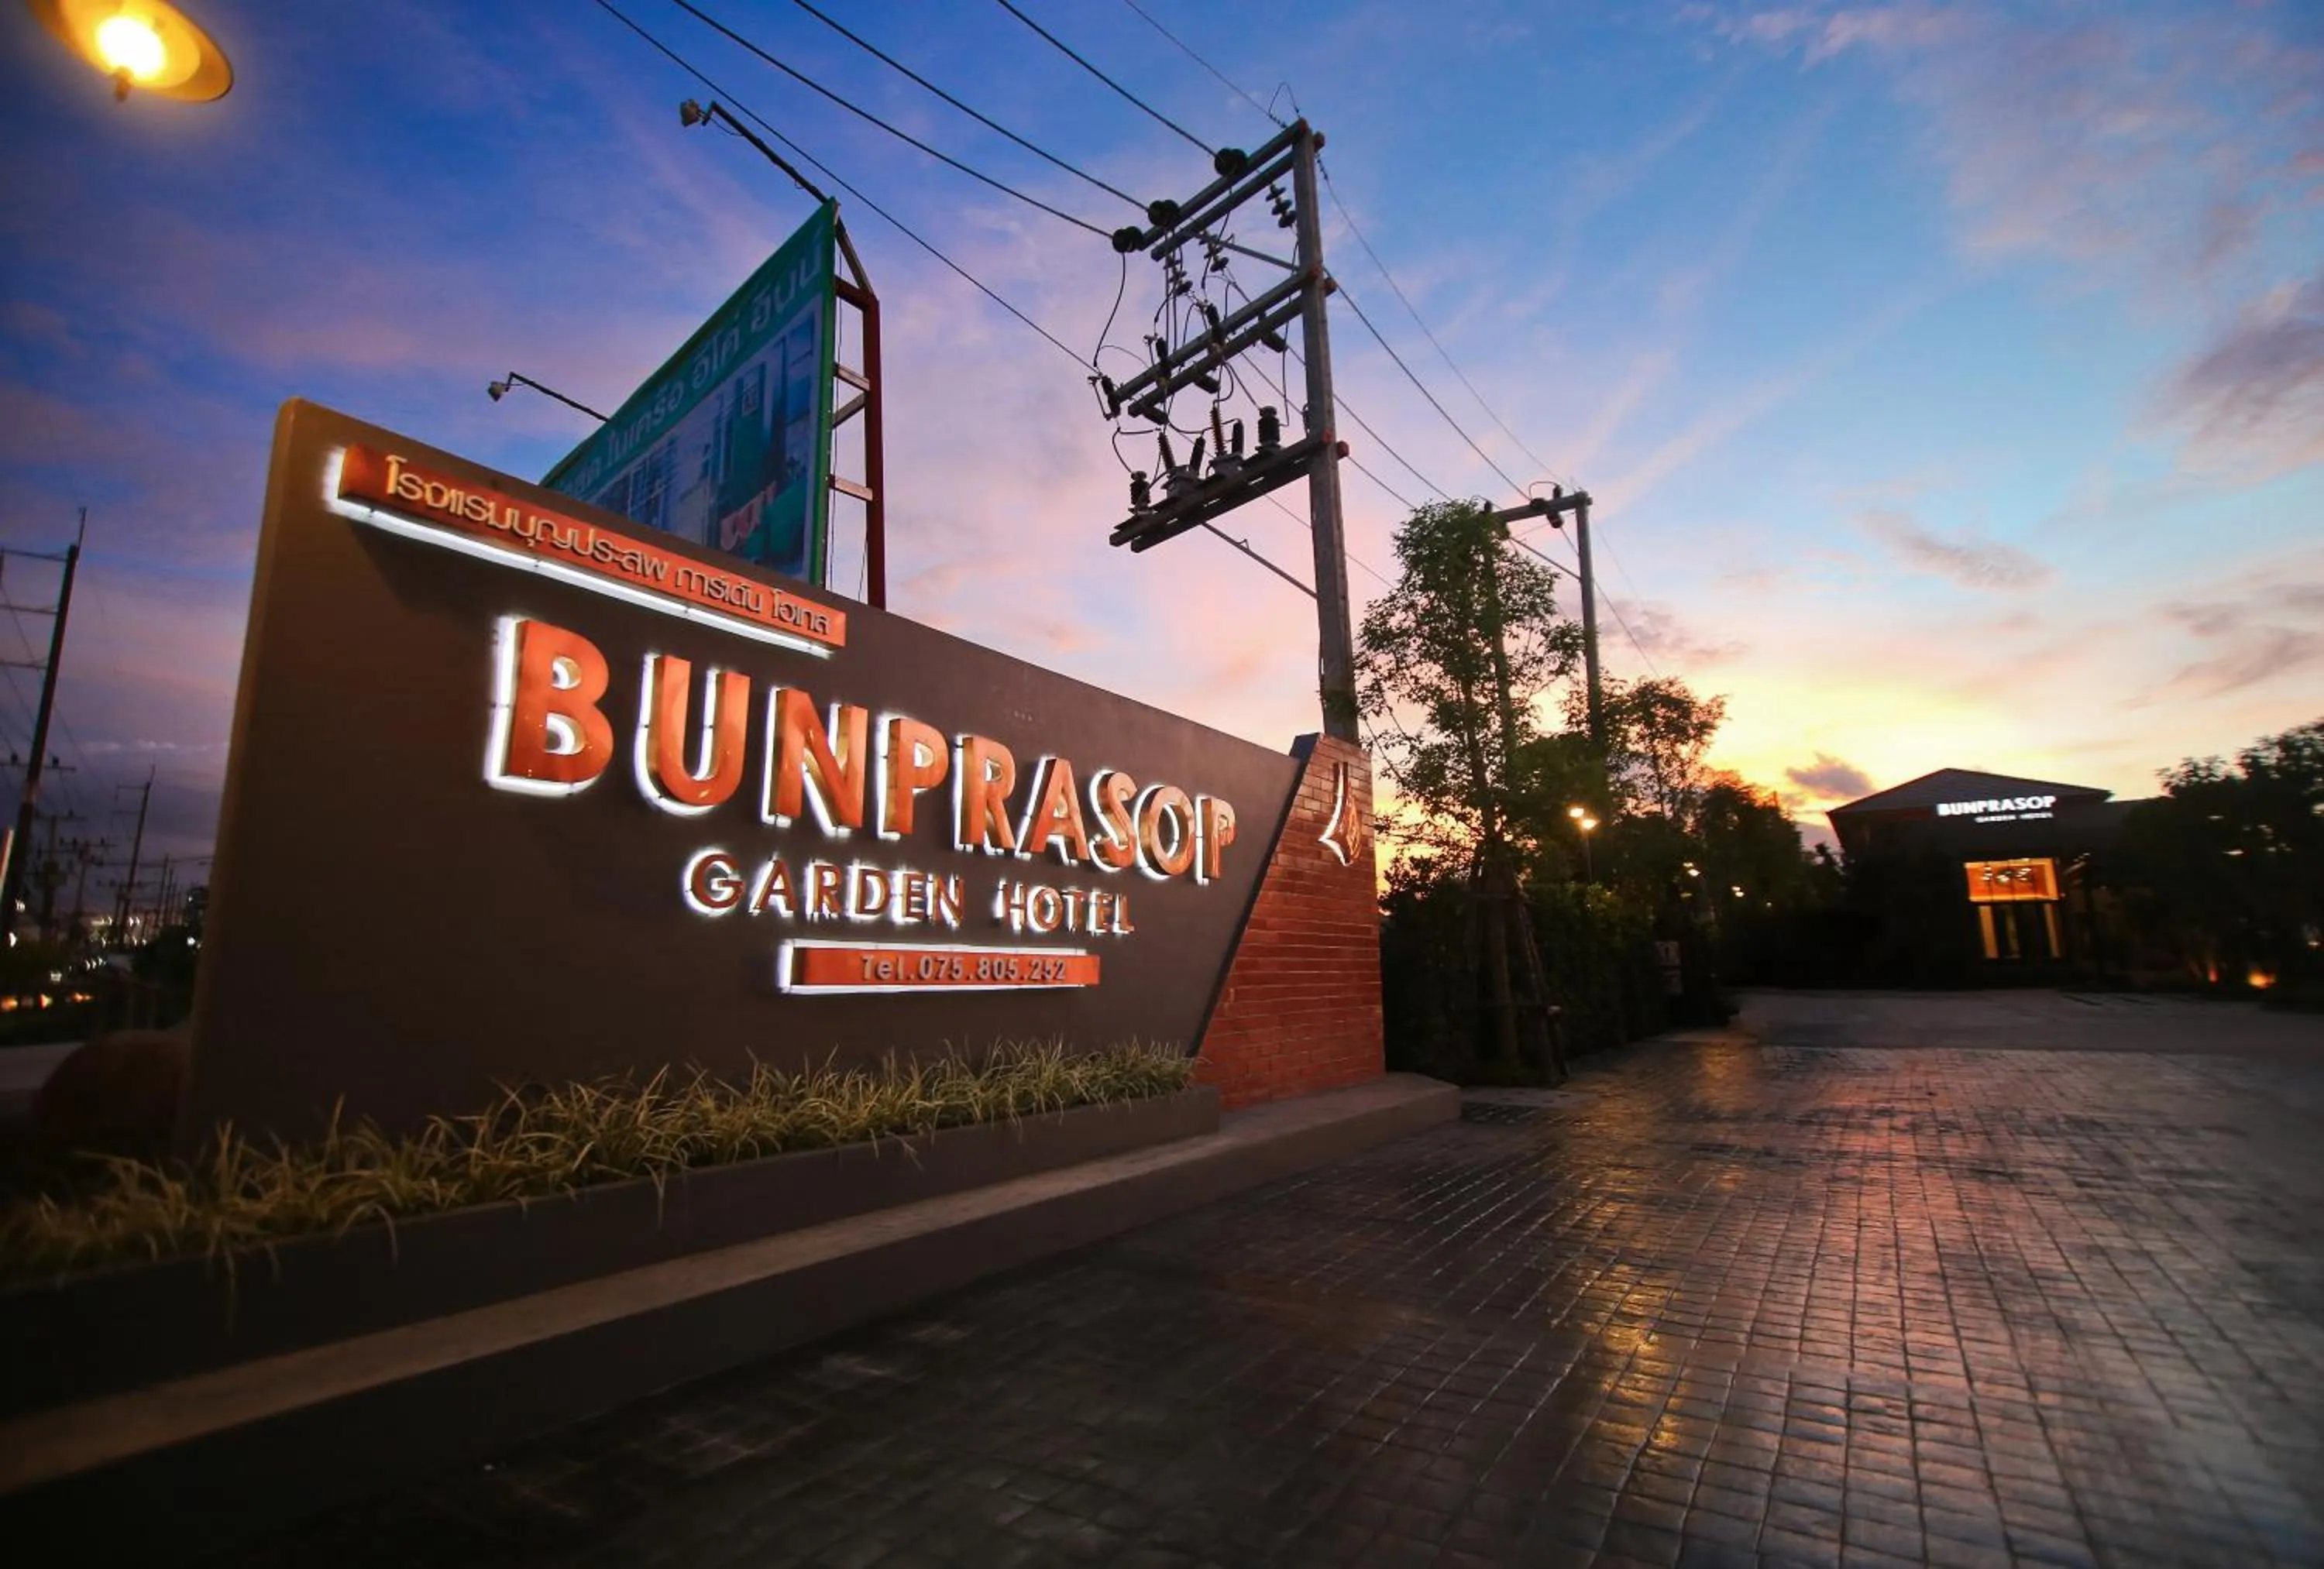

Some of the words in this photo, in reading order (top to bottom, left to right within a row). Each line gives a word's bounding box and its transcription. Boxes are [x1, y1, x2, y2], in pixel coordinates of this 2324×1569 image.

[490, 617, 1237, 884] BUNPRASOP
[1936, 795, 2057, 816] BUNPRASOP
[685, 850, 965, 928] GARDEN
[996, 878, 1136, 935] HOTEL
